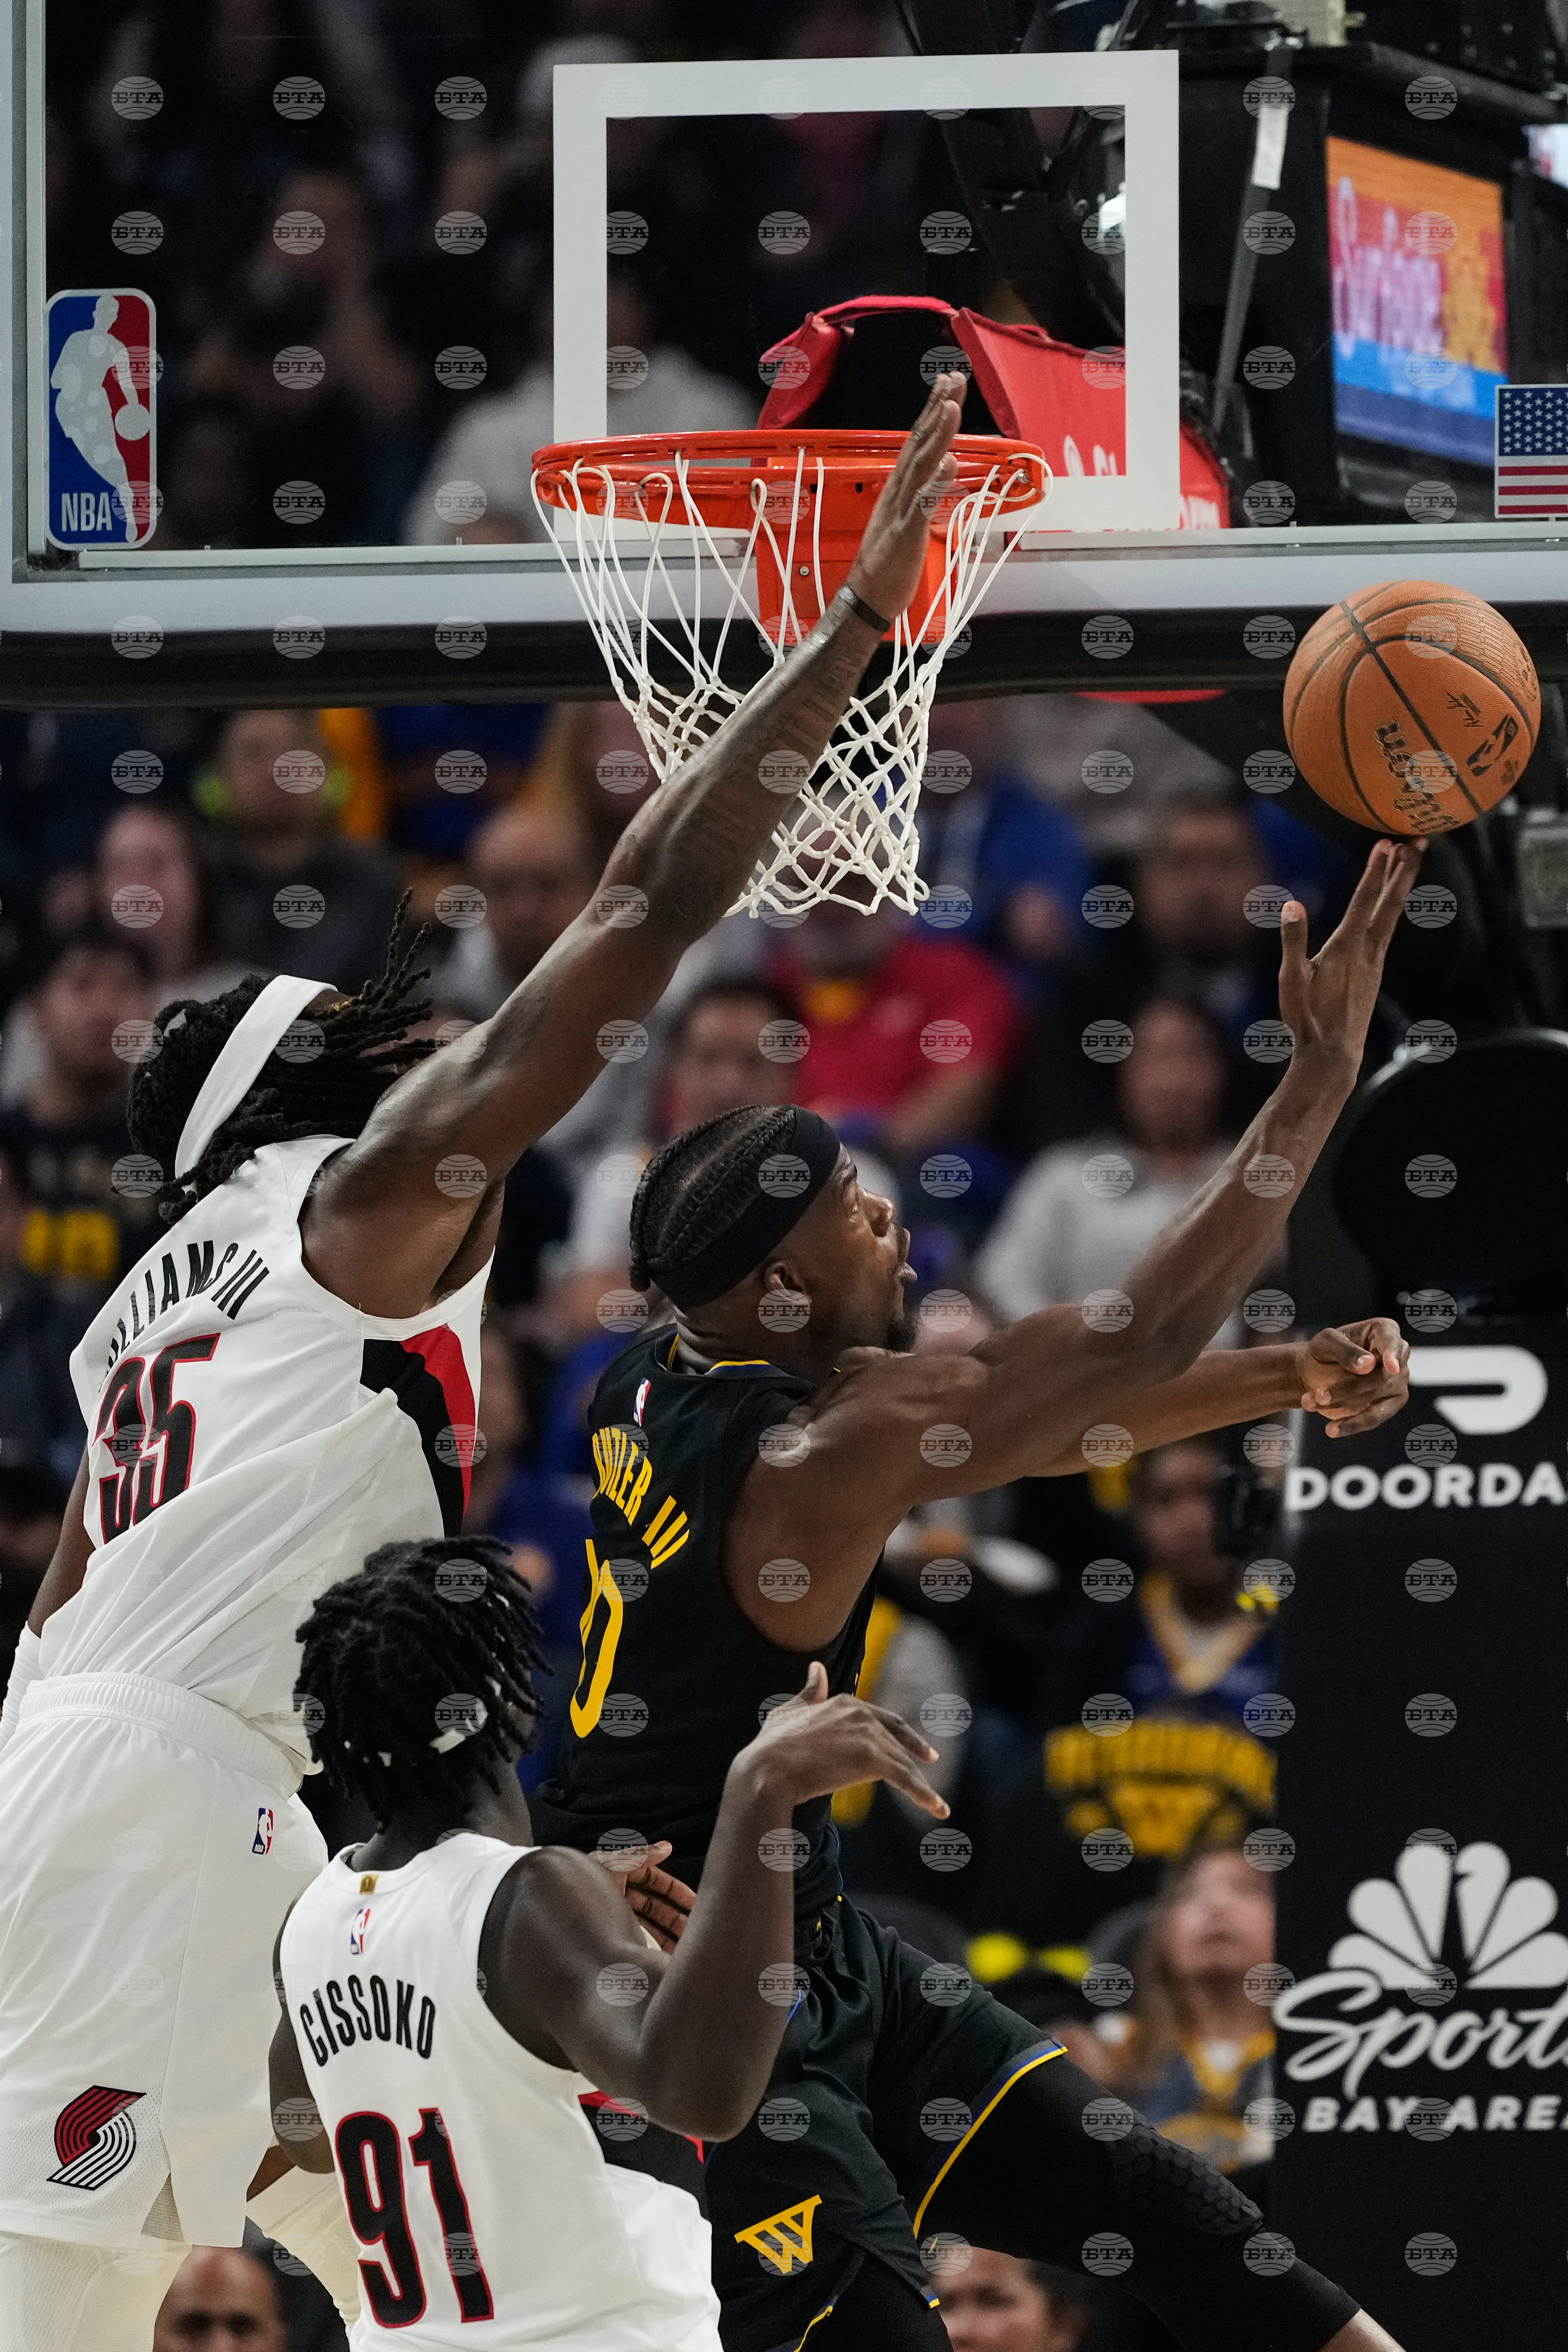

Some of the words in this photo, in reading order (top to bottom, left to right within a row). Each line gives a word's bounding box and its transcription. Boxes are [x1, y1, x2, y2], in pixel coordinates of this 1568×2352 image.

[61, 492, 113, 531] NBA
[98, 1240, 239, 1393] ILLIAMS
[91, 1332, 221, 1545] 35
[1286, 1461, 1568, 1511] DOORDA
[254, 1844, 264, 1853] NBA
[300, 1975, 436, 2067] CISSOKO
[1272, 1970, 1568, 2100] Sport
[1303, 2095, 1421, 2133] BAY
[1440, 2095, 1568, 2131] ARE
[335, 2108, 494, 2329] 91
